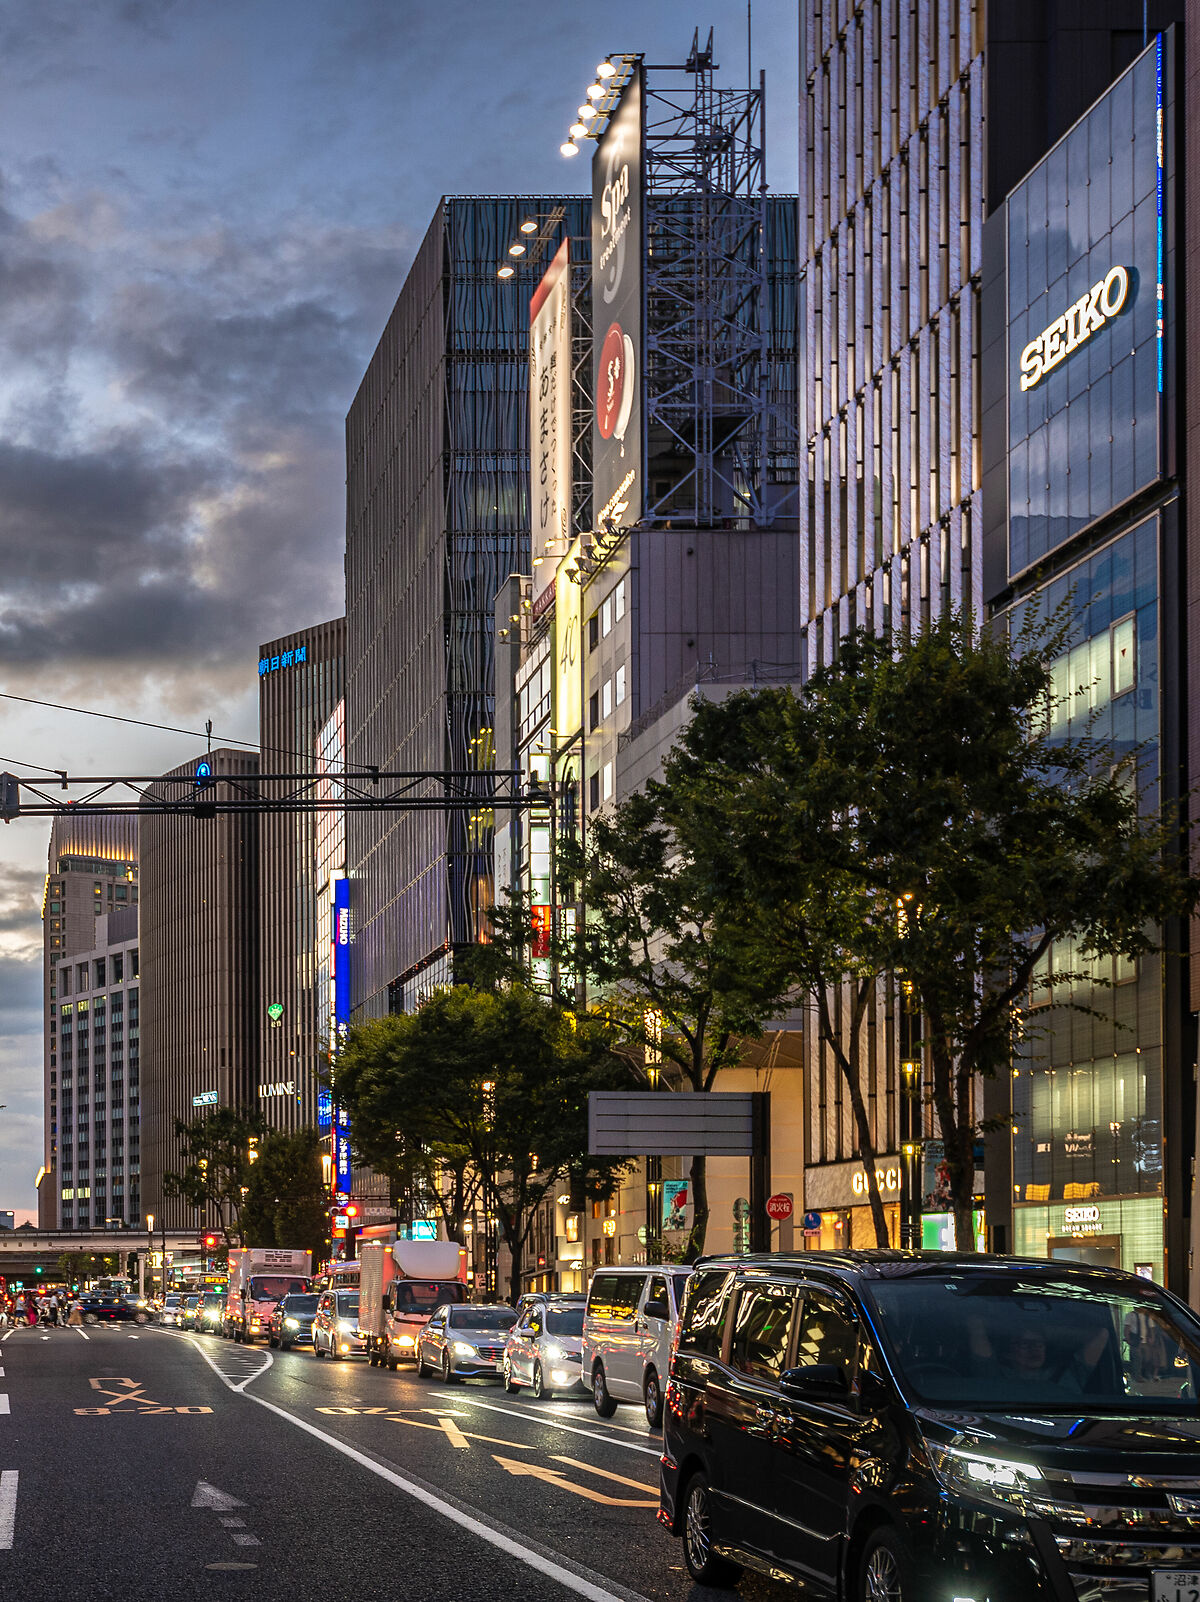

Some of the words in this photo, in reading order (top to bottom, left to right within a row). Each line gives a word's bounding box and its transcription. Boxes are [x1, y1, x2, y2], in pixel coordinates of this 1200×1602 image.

[601, 163, 630, 239] Spa
[1019, 265, 1129, 393] SEIKO
[257, 645, 307, 677] 朝日新聞
[339, 907, 349, 946] MIZUHO
[258, 1081, 295, 1098] LUMINE
[769, 1202, 791, 1213] 消火栓
[1064, 1206, 1100, 1223] SEIKO
